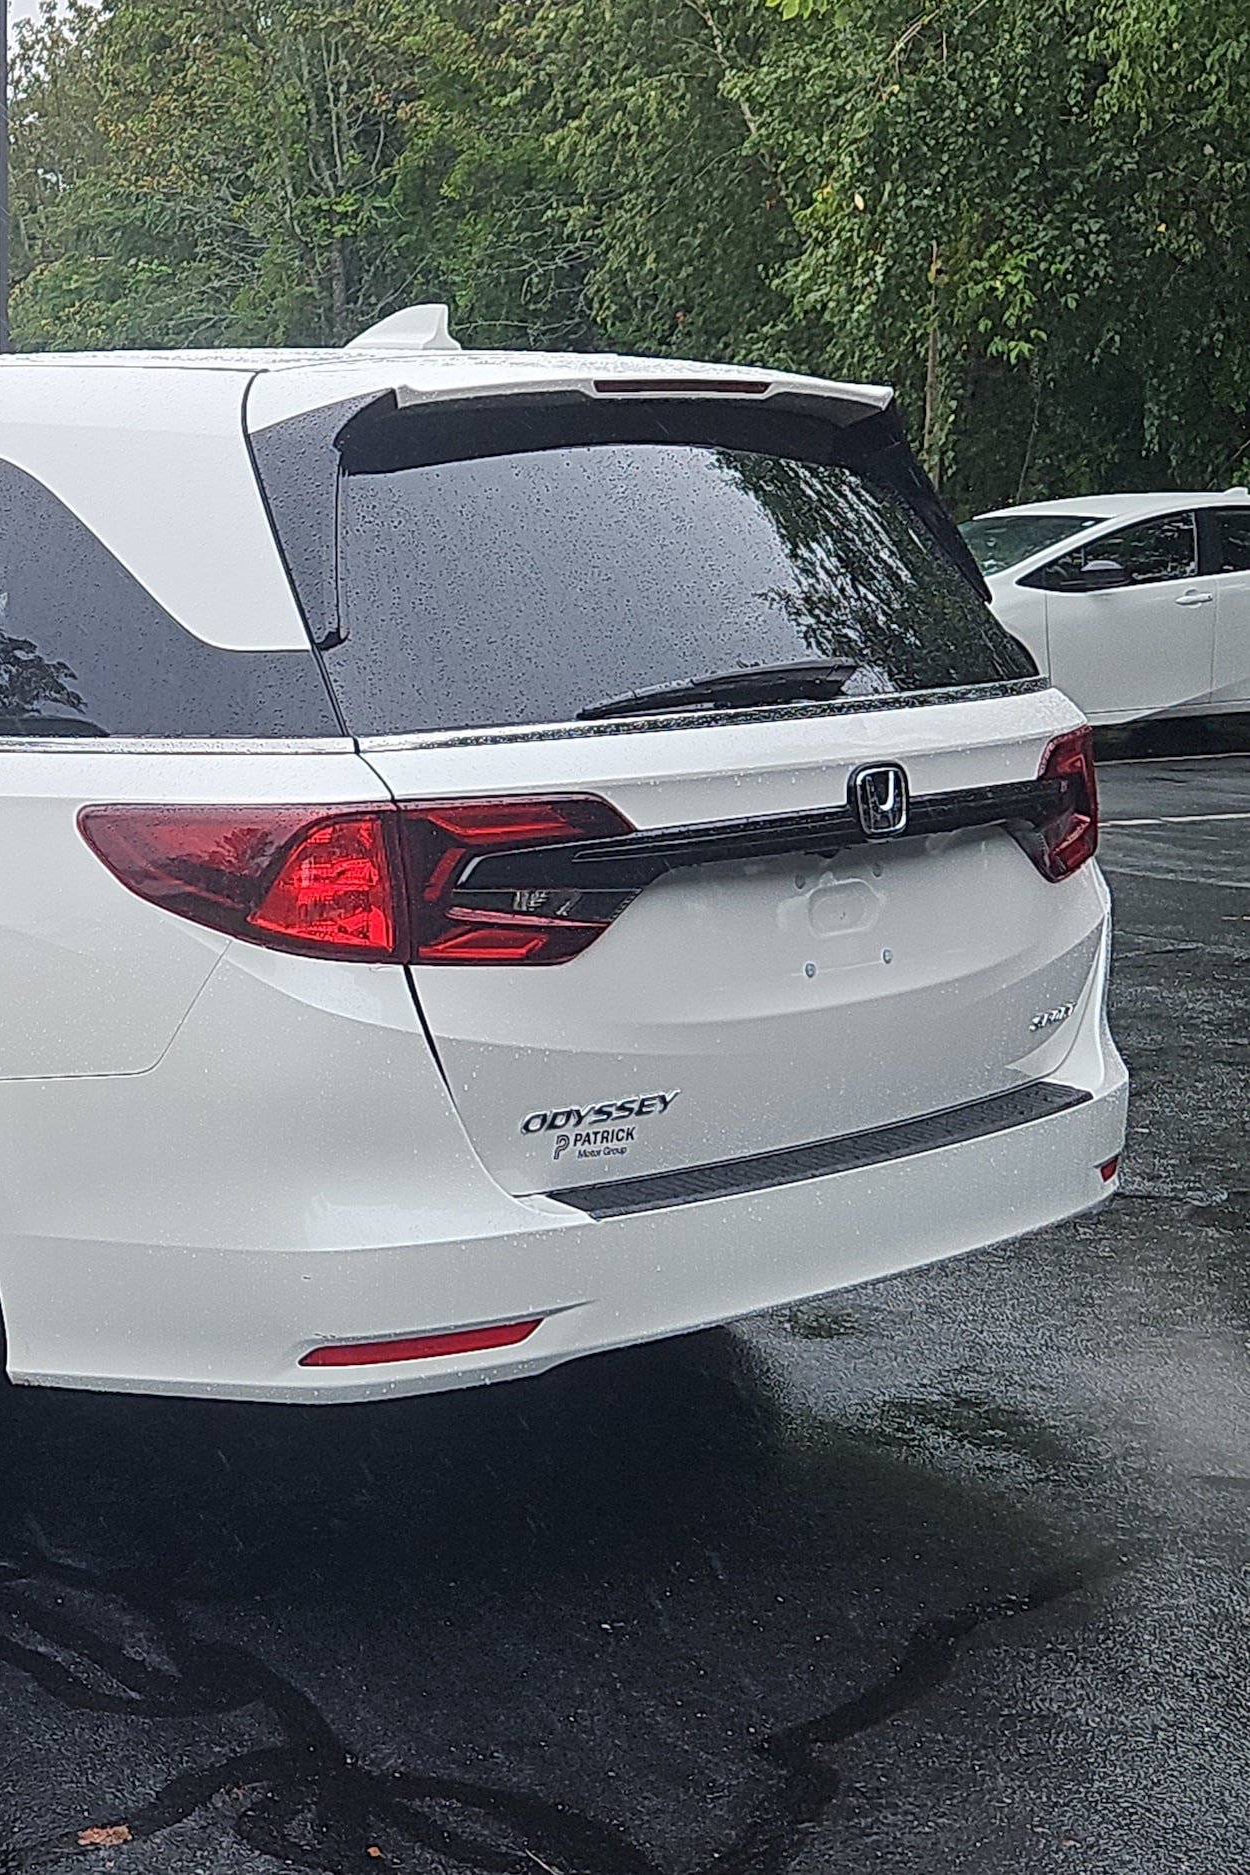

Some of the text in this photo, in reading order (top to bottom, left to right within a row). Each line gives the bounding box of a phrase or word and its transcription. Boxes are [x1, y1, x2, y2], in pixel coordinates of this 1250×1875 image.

[521, 1088, 681, 1134] ODYSSEY
[573, 1127, 636, 1147] PATRICK
[577, 1146, 627, 1159] Motor Group
